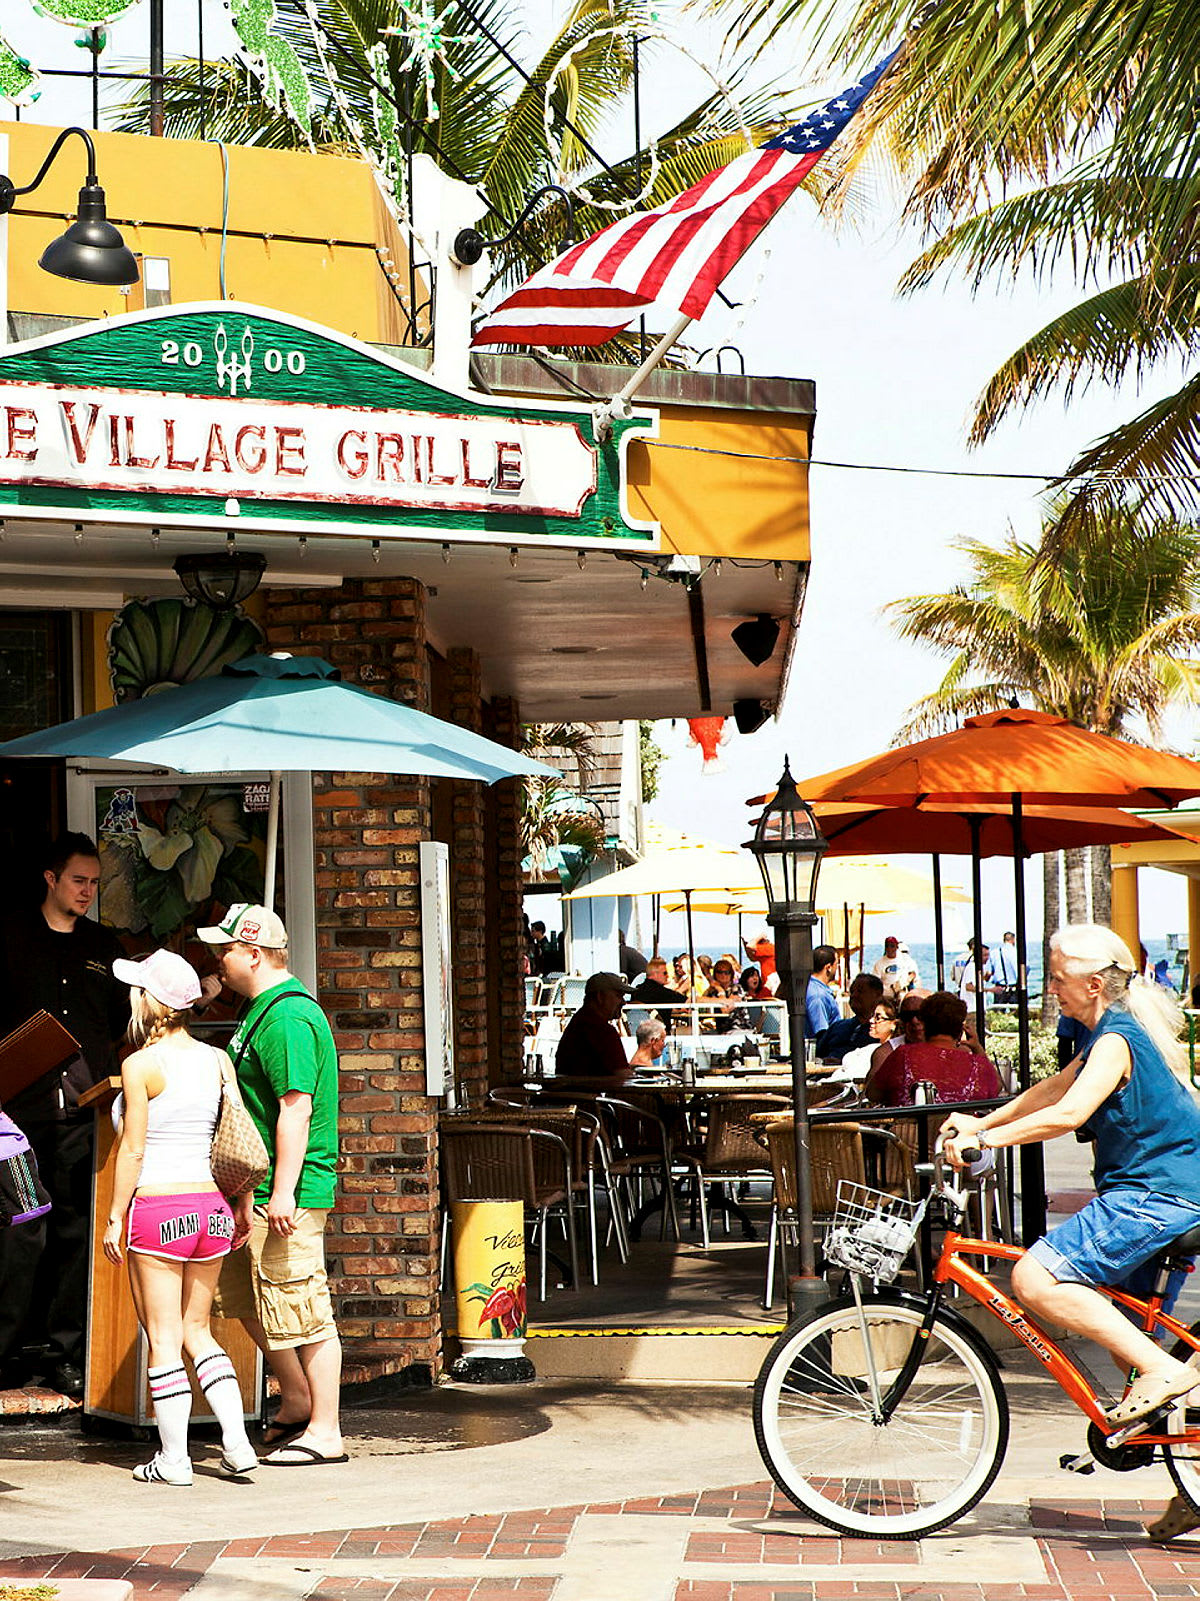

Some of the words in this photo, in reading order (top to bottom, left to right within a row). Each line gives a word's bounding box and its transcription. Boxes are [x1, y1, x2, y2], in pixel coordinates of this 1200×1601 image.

[161, 340, 203, 366] 20
[264, 349, 306, 375] 00
[57, 400, 308, 478] VILLAGE
[337, 429, 525, 490] GRILLE
[160, 1213, 200, 1245] MIAMI
